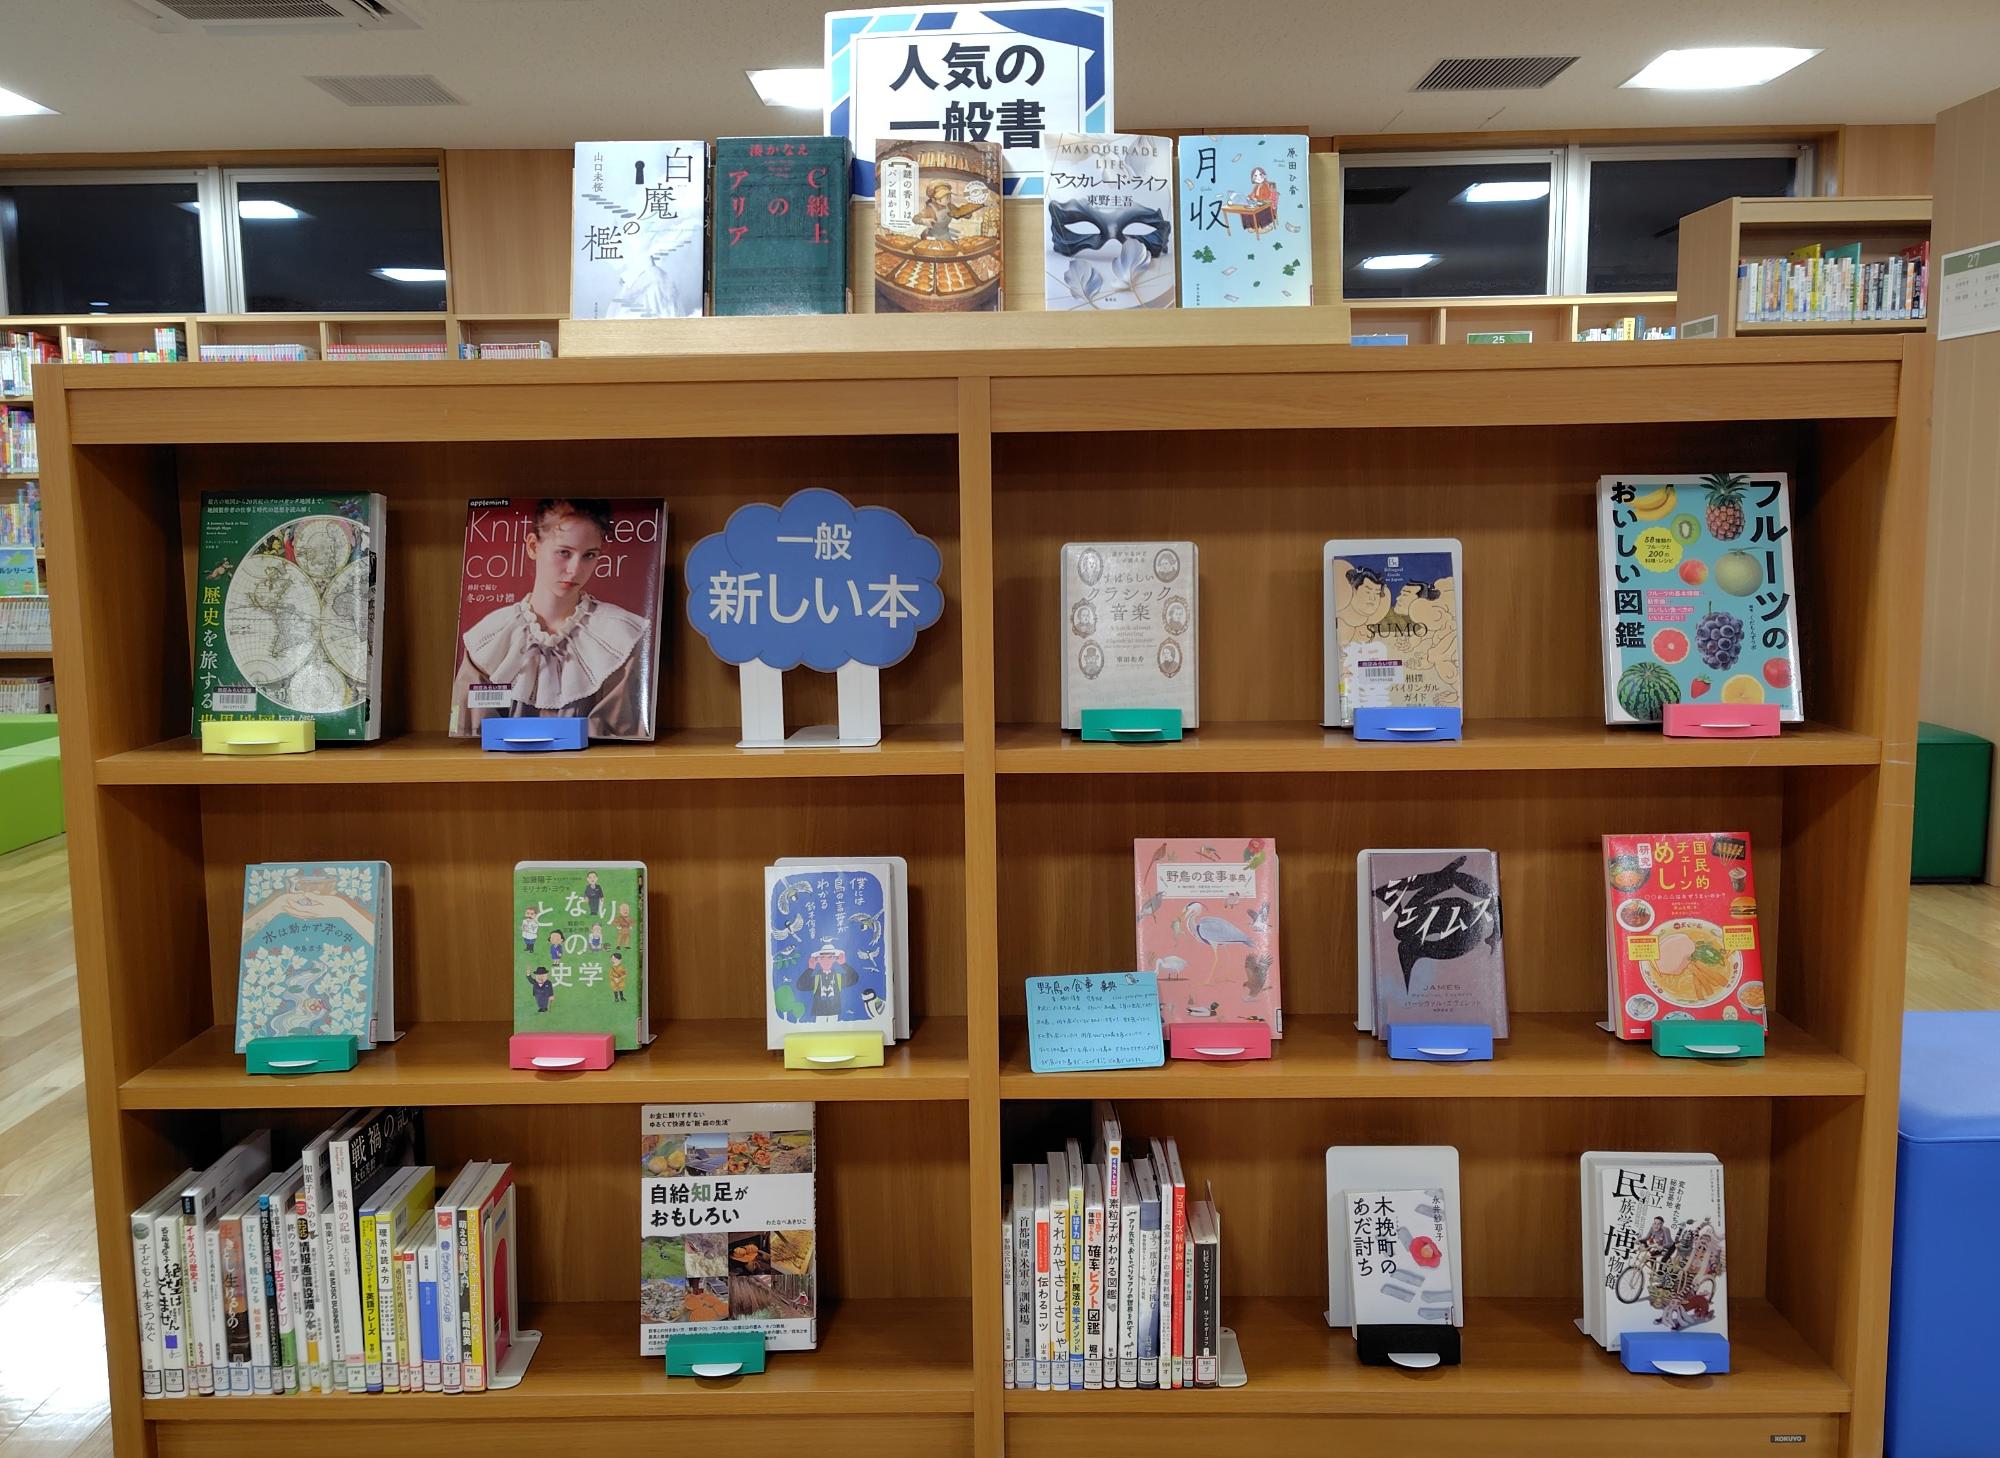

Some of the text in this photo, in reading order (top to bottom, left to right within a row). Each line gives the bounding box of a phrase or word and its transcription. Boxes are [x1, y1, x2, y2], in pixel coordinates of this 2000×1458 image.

[889, 42, 1045, 91] 人気の
[889, 99, 1046, 149] 一般書
[1061, 143, 1158, 157] MASQUERADE
[1095, 159, 1125, 170] LIFE
[887, 168, 899, 219] パン屋から
[1050, 172, 1168, 192] マスカレード・ライフ
[1087, 195, 1133, 207] 東野圭吾
[728, 170, 749, 246] アリア
[1967, 253, 1980, 268] 27
[1492, 336, 1505, 344] 25
[777, 522, 852, 561] 一般
[1611, 481, 1646, 649] おいしい図鑑
[1750, 480, 1790, 650] フルーツの
[709, 570, 920, 628] 新しい本
[1087, 587, 1172, 602] クラシック
[1110, 603, 1151, 621] 音楽
[200, 586, 221, 709] 歴史を旅する
[1367, 622, 1428, 639] SUMO
[1405, 674, 1424, 682] 相撲
[1654, 841, 1676, 890] めし
[1677, 841, 1692, 890] チェーン
[1693, 841, 1710, 890] 国民的
[535, 891, 616, 926] となり
[816, 878, 829, 910] わかる
[834, 878, 848, 934] 鳥の言葉が
[850, 877, 868, 906] 僕には
[565, 934, 588, 955] の
[551, 962, 603, 987] 史学
[351, 1107, 418, 1169] 戦禍の記
[651, 1182, 748, 1204] 自給知足が
[651, 1207, 739, 1227] おもしろい
[378, 1228, 390, 1285] 理系の読み方
[1107, 1198, 1119, 1300] 素粒子がわかる図鑑
[1353, 1198, 1374, 1277] あだ討ち
[1373, 1196, 1397, 1274] 木挽町の
[139, 1244, 156, 1342] 子どもと本をつなぐ
[1037, 1277, 1049, 1332] 伝わるコツ
[1087, 1245, 1102, 1335] 確率ピクト図鑑
